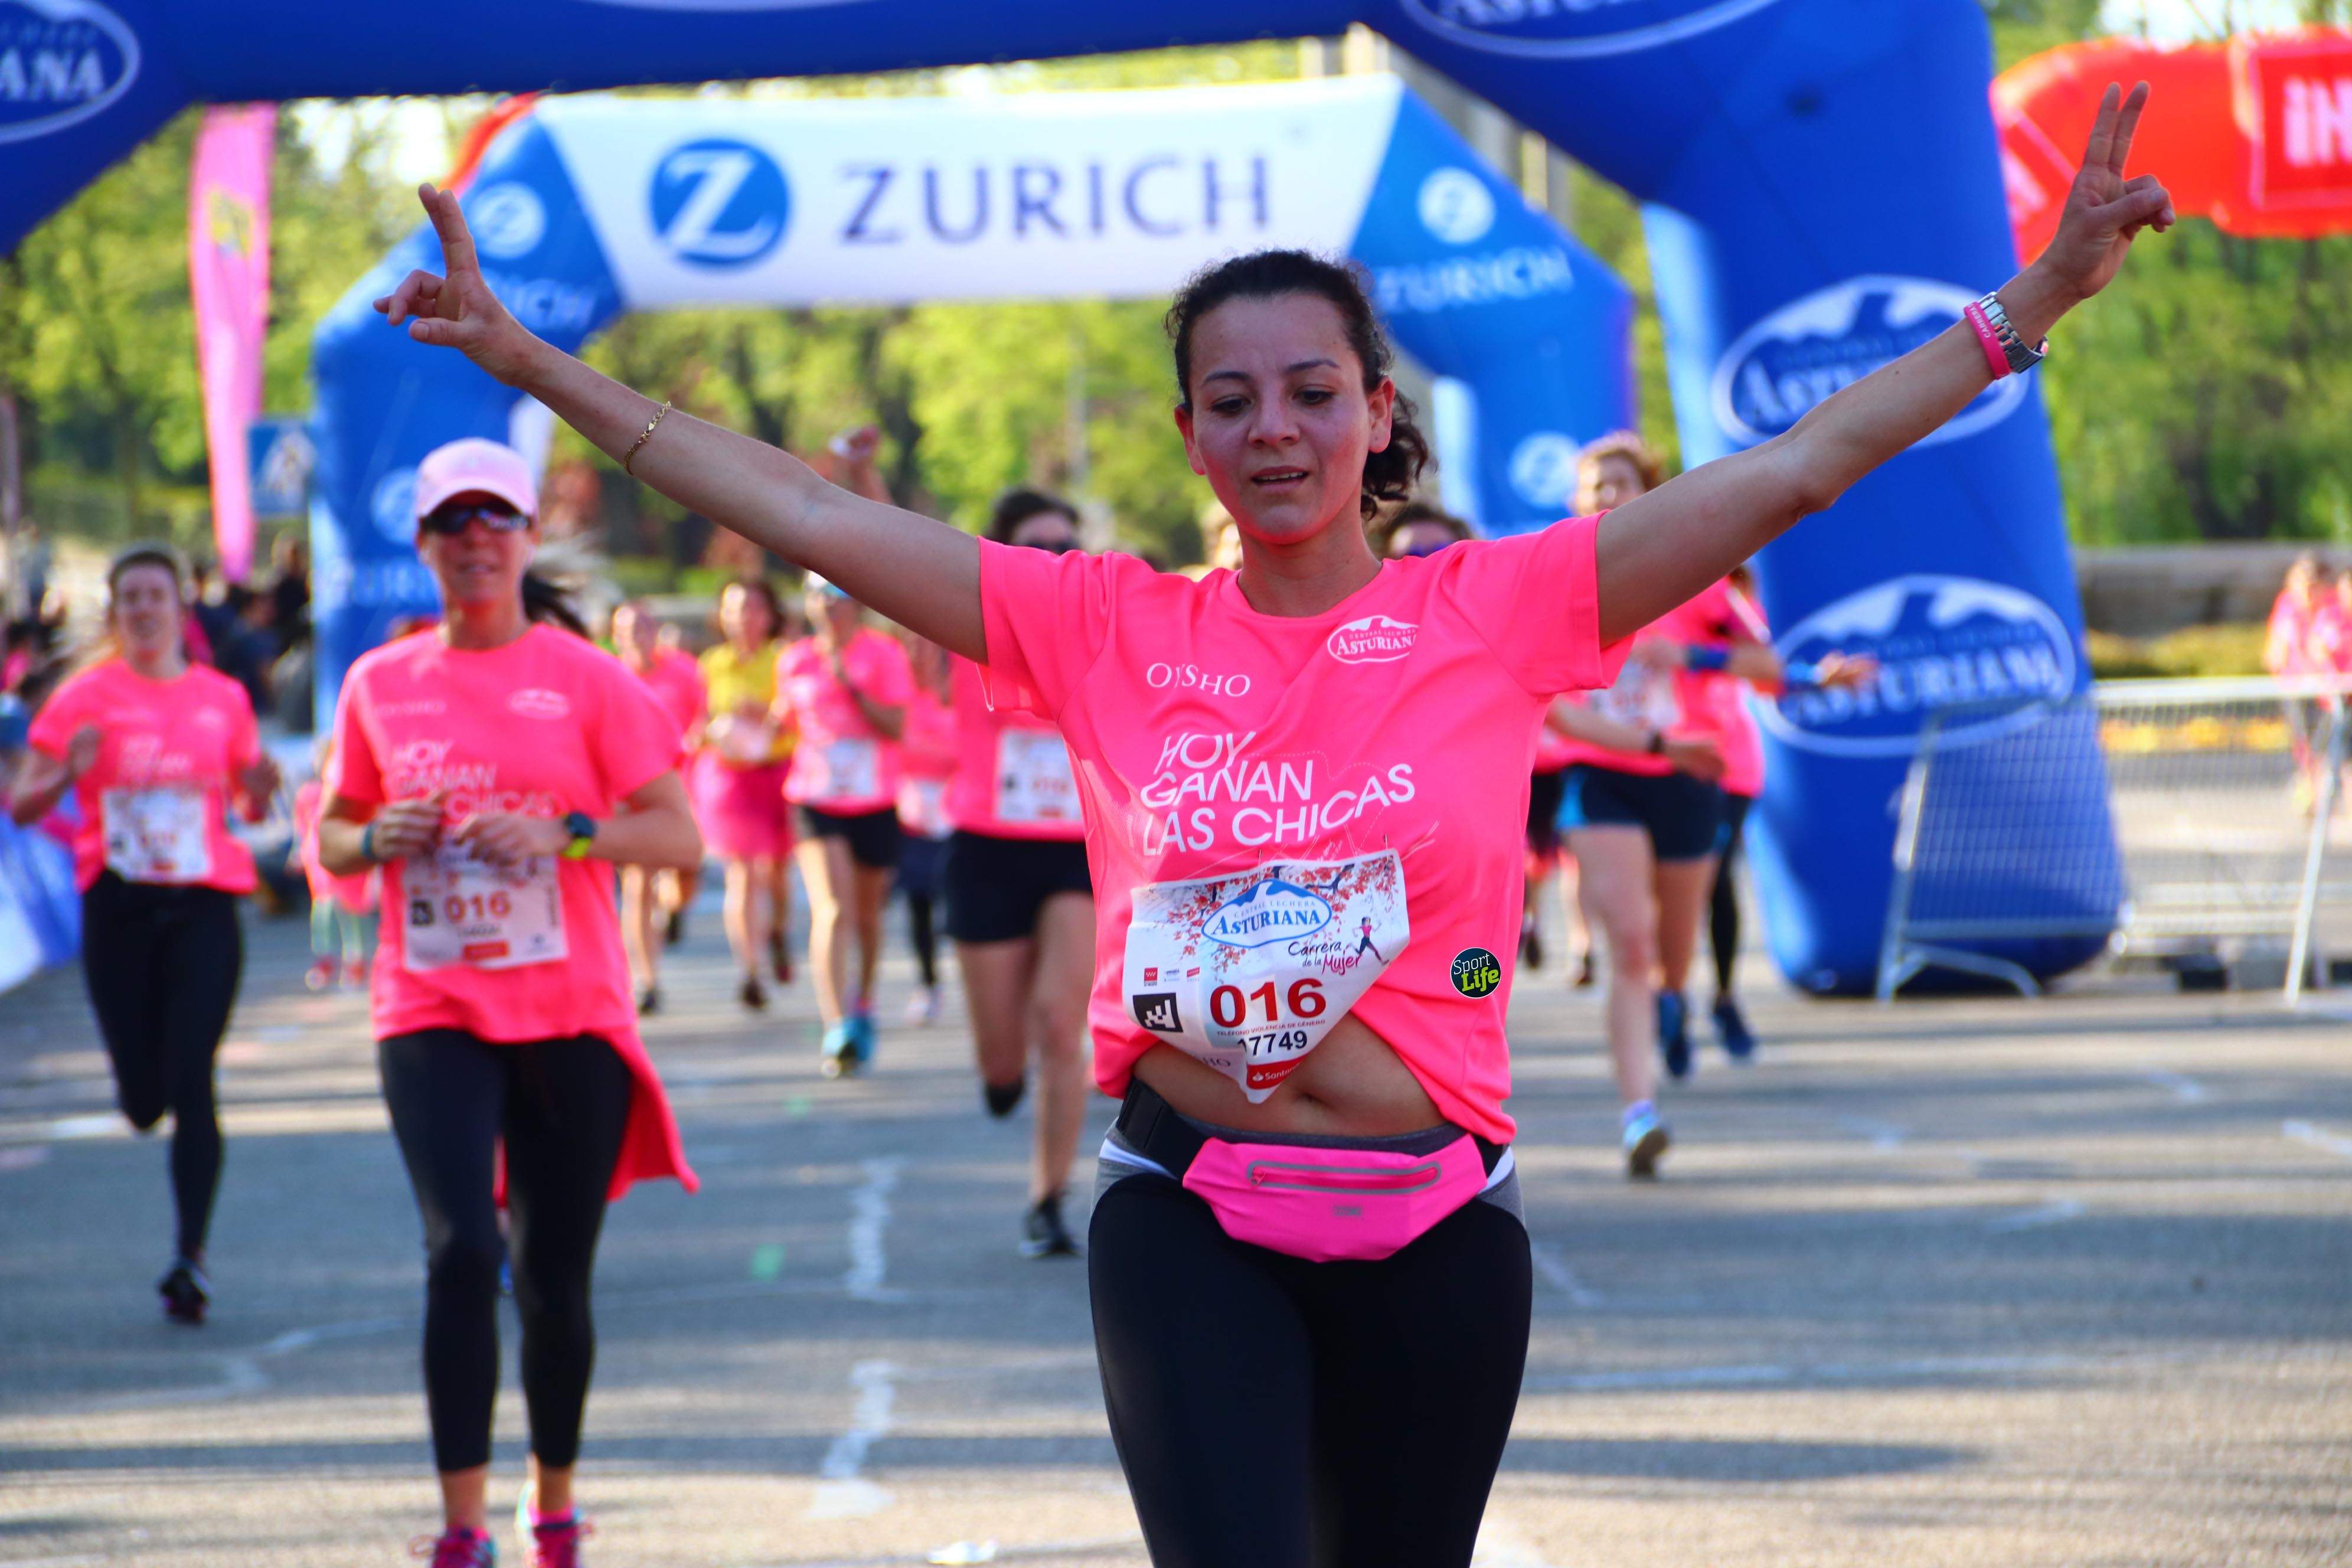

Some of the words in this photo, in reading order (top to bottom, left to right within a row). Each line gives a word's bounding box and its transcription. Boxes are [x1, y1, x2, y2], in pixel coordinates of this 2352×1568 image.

[837, 155, 1269, 244] ZURICH
[1153, 731, 1256, 775] HOY
[1140, 758, 1313, 808] GANAN
[1143, 807, 1216, 855] LAS
[1231, 763, 1415, 847] CHICAS
[445, 890, 512, 925] 016
[1211, 909, 1321, 935] ASTURIANA
[1234, 901, 1266, 918] CENTRAL
[1288, 941, 1342, 956] Carrera
[1302, 957, 1312, 967] de
[1314, 954, 1322, 966] la
[1321, 950, 1360, 975] Mujer
[1210, 978, 1327, 1028] 016
[1237, 1030, 1308, 1056] 17749
[1250, 1024, 1286, 1034] VIOLENCIA
